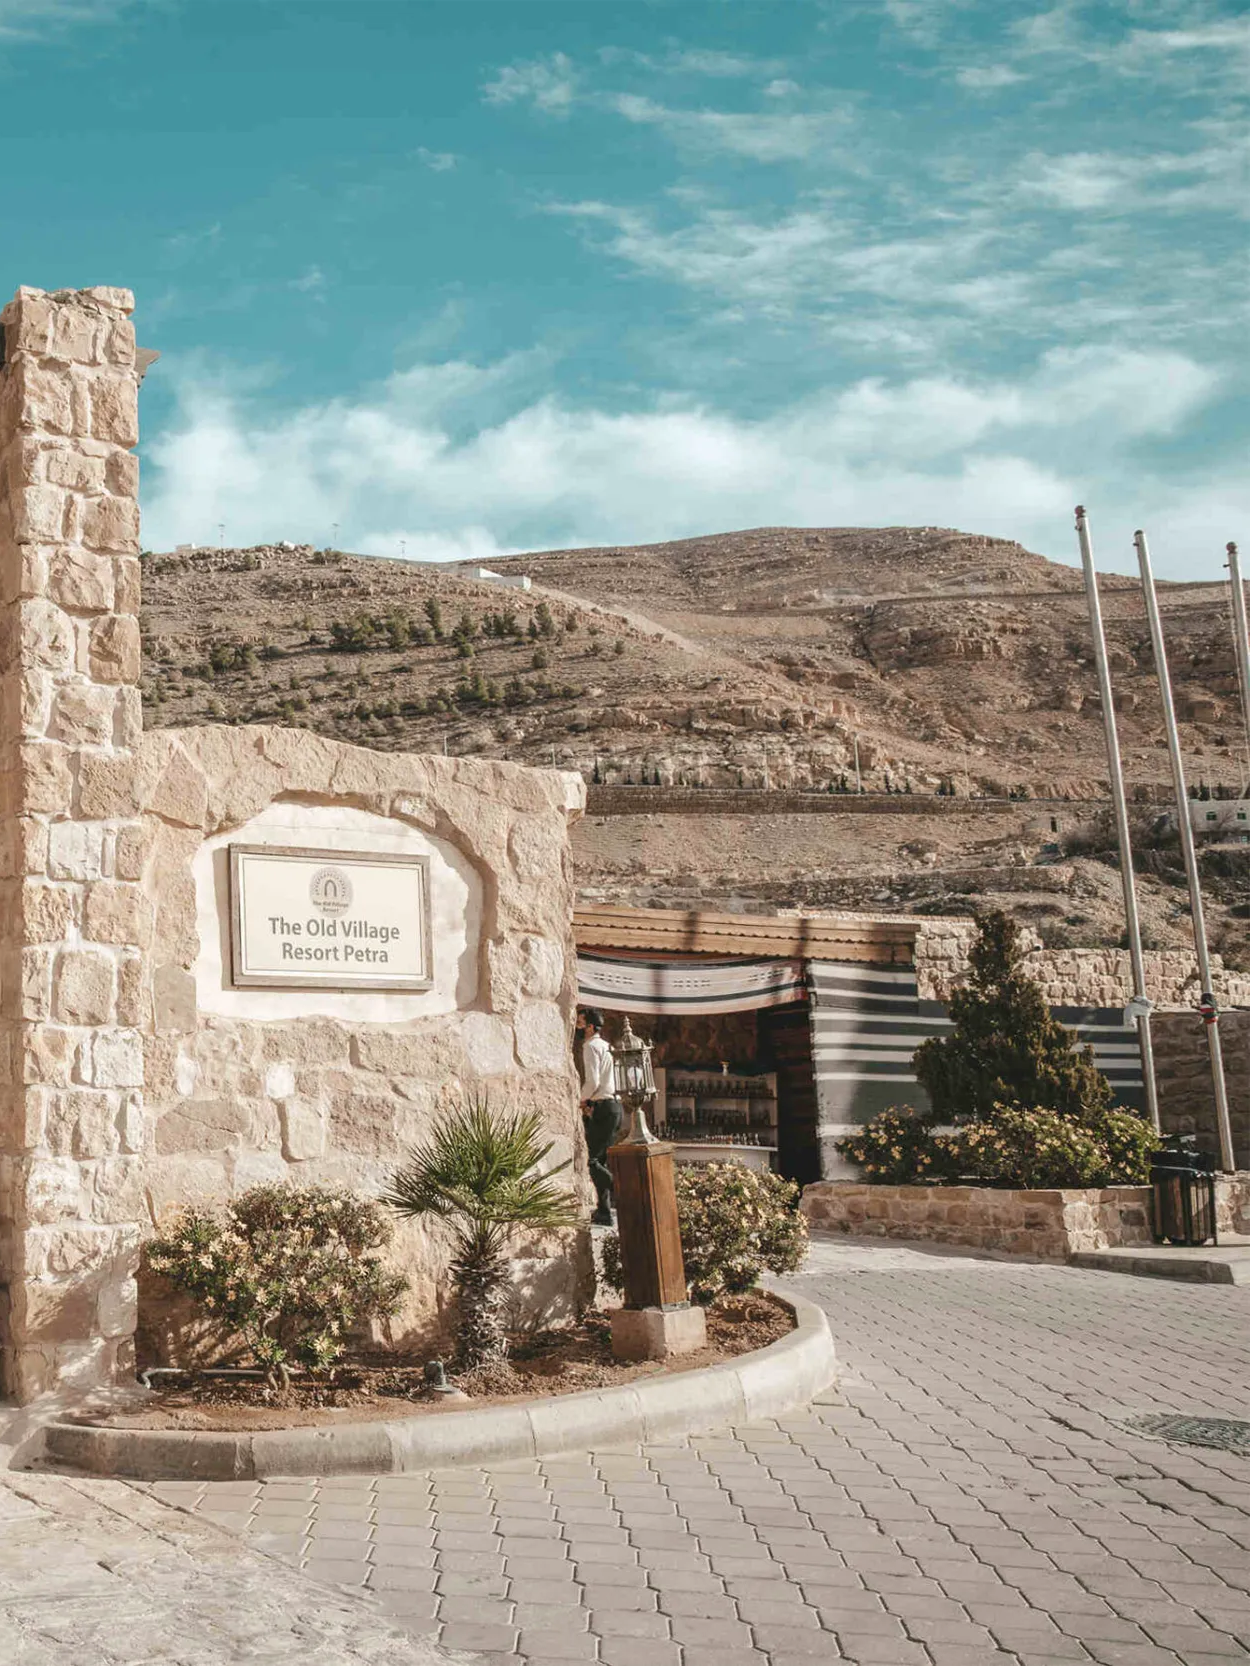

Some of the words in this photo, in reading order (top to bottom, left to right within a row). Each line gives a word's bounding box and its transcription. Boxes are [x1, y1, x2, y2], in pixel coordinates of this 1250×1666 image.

[268, 917, 302, 935] The
[306, 919, 337, 937] Old
[340, 920, 400, 943] Village
[282, 942, 339, 961] Resort
[344, 945, 389, 963] Petra
